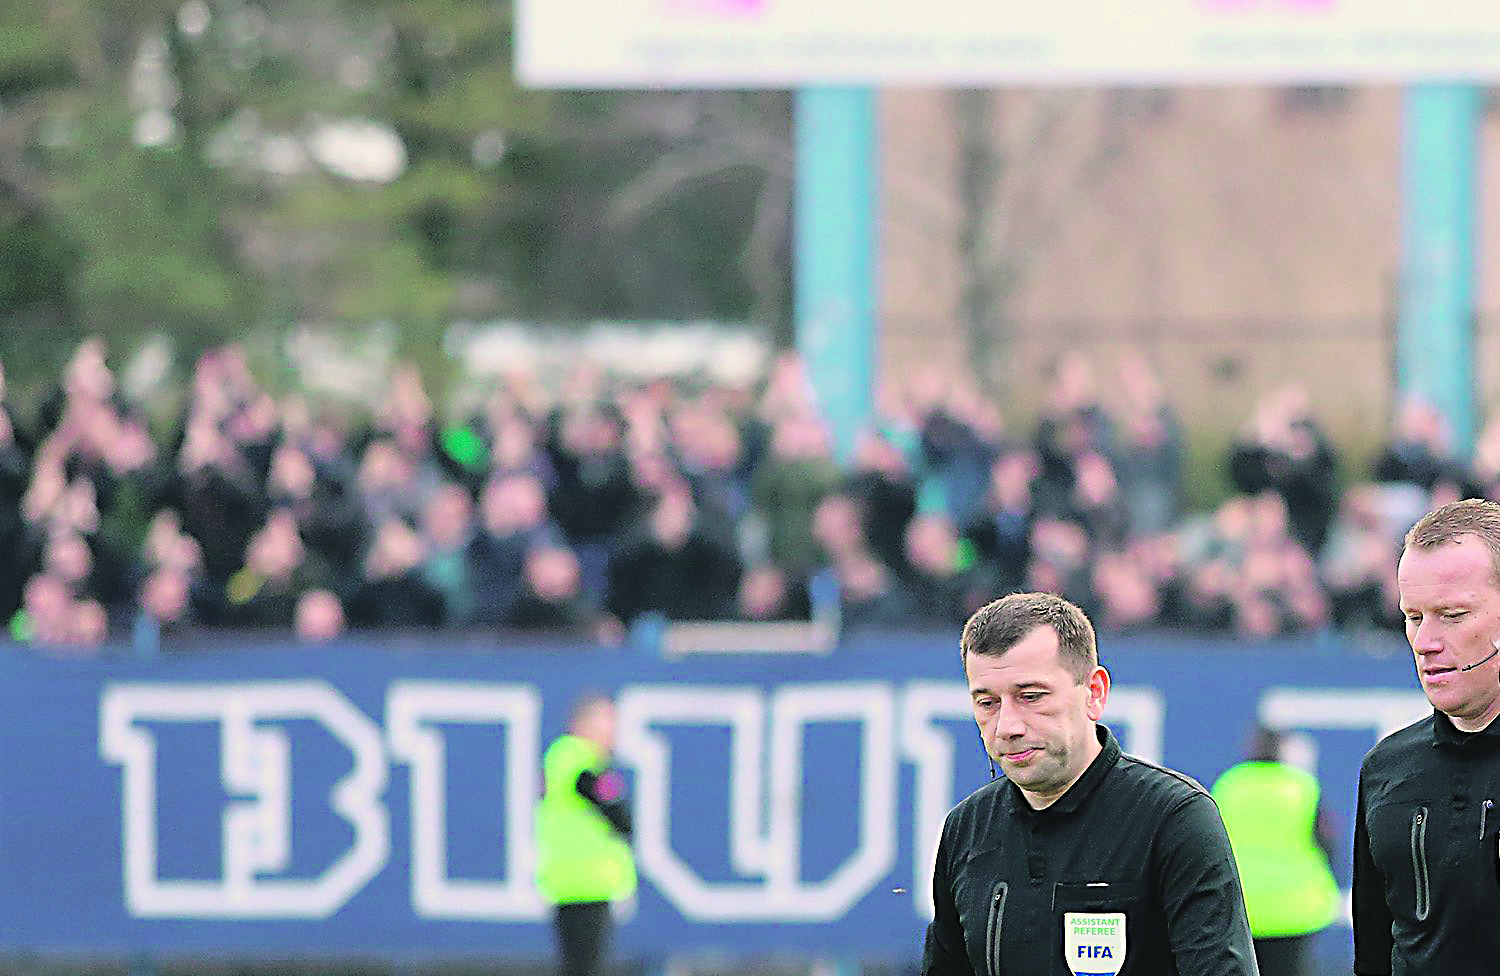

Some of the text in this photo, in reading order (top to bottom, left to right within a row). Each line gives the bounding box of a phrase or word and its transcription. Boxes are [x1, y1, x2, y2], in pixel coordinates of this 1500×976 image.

[1070, 918, 1120, 926] ASSISTANT
[1073, 927, 1116, 936] REFEREE
[1077, 945, 1113, 959] FIFA
